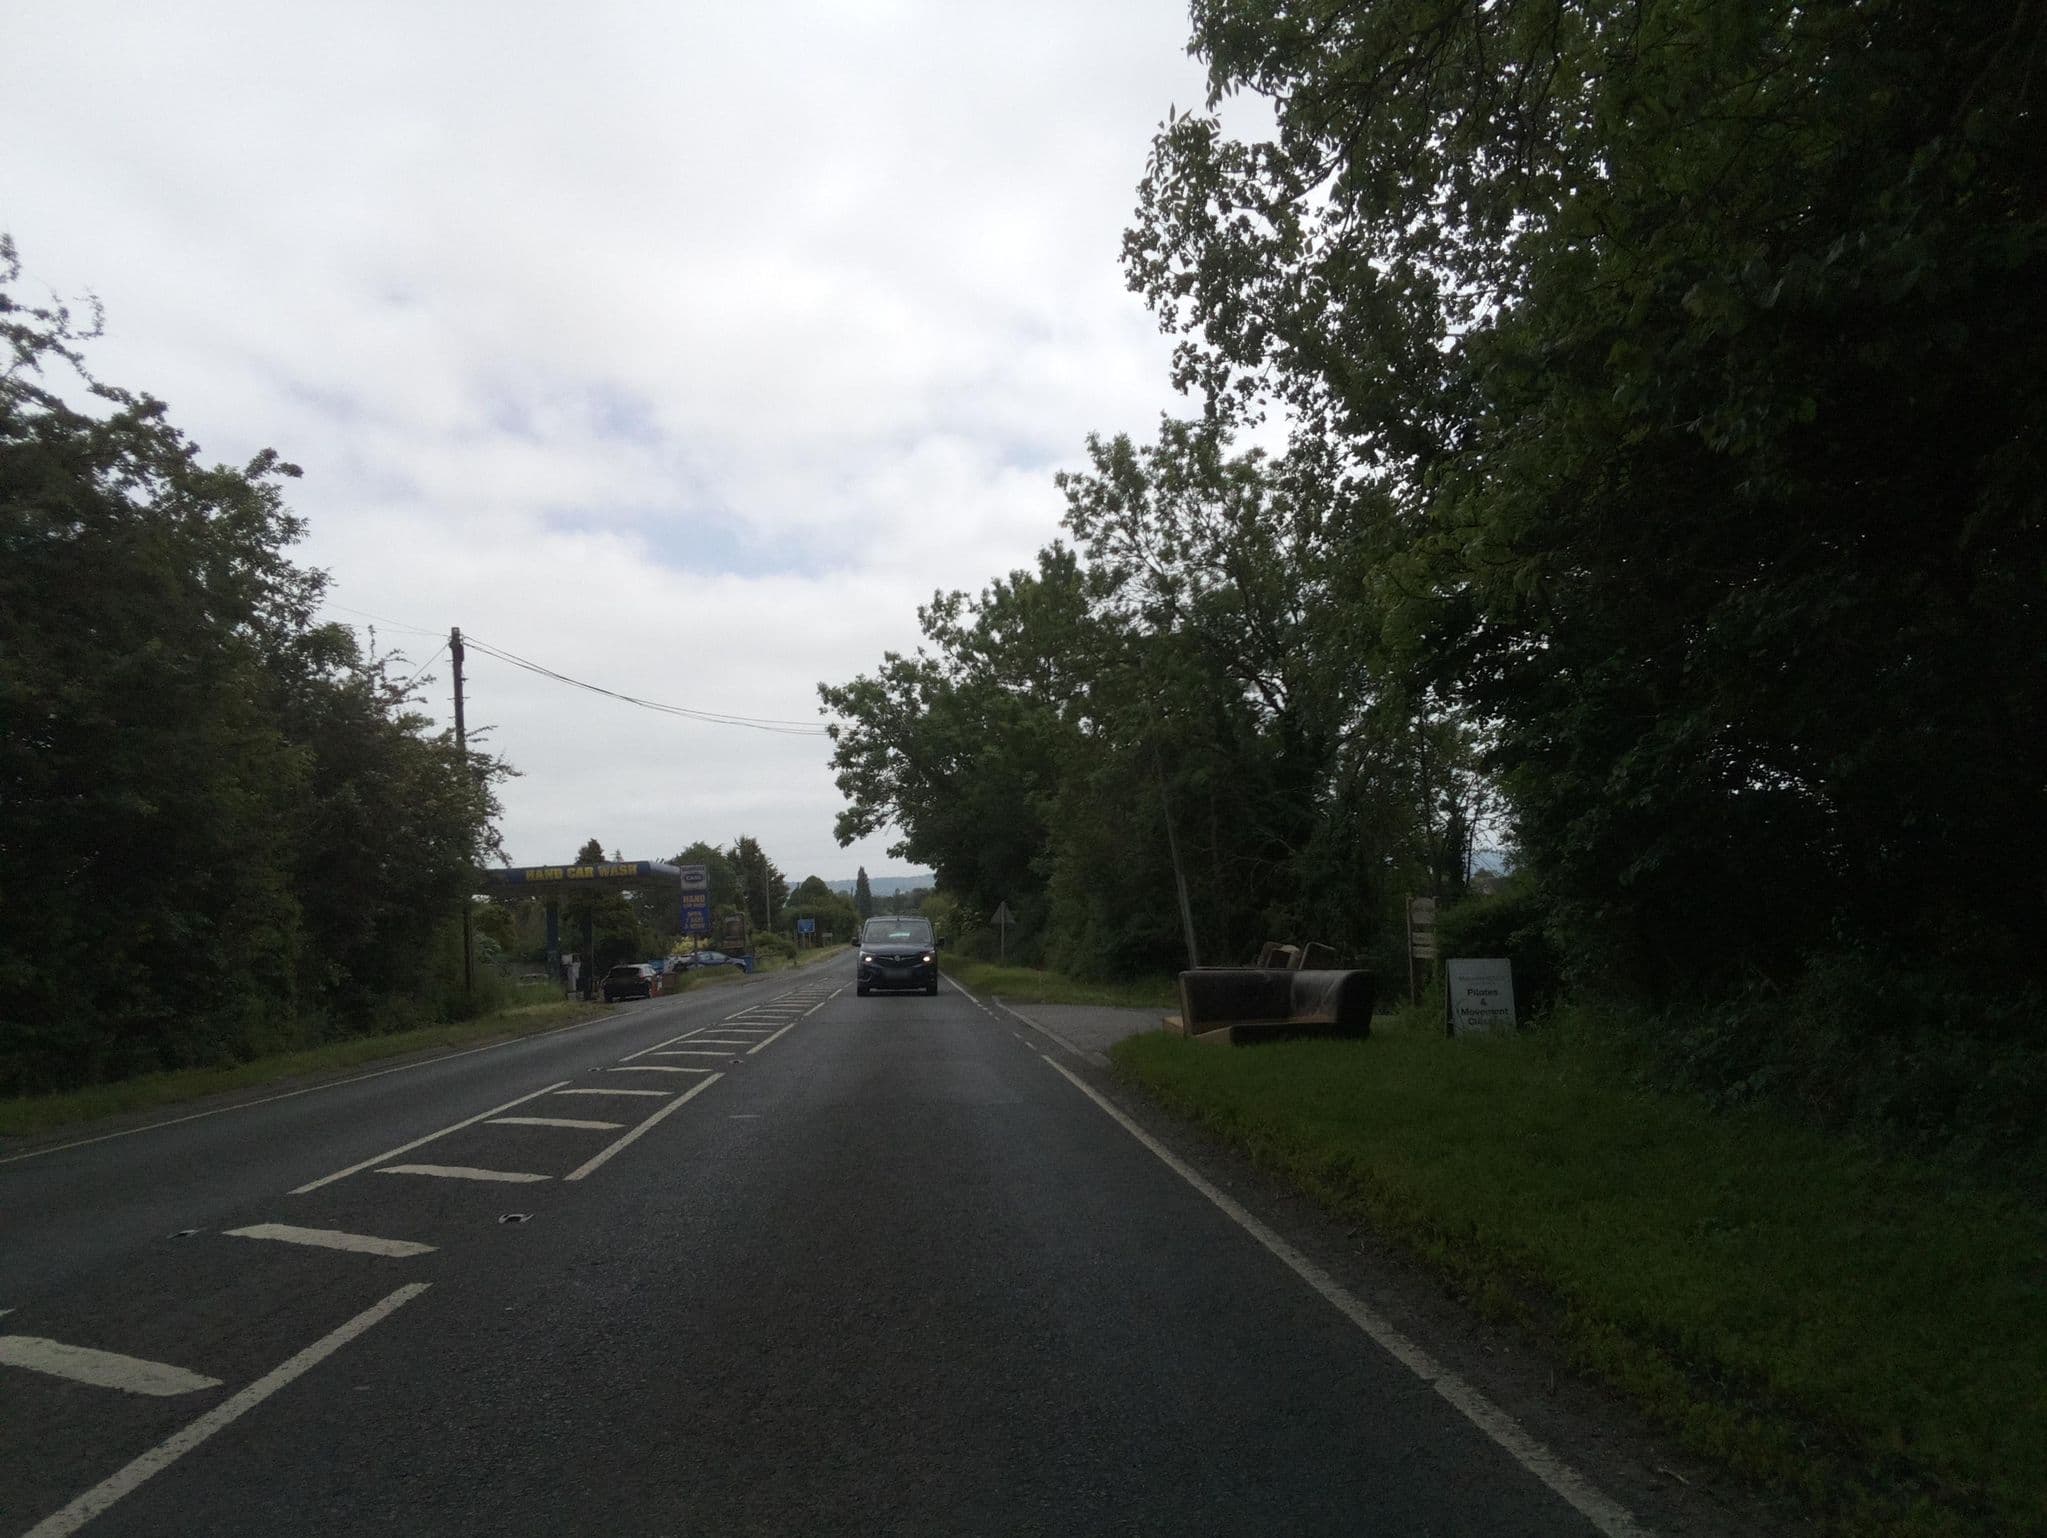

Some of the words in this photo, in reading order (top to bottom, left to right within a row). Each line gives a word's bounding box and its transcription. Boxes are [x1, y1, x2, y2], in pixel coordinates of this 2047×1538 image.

[526, 868, 563, 880] HAND
[566, 866, 594, 879] CAR
[598, 864, 638, 877] WASH
[1467, 988, 1498, 996] Pilates
[1480, 998, 1488, 1006] &
[1461, 1008, 1509, 1016] Movement
